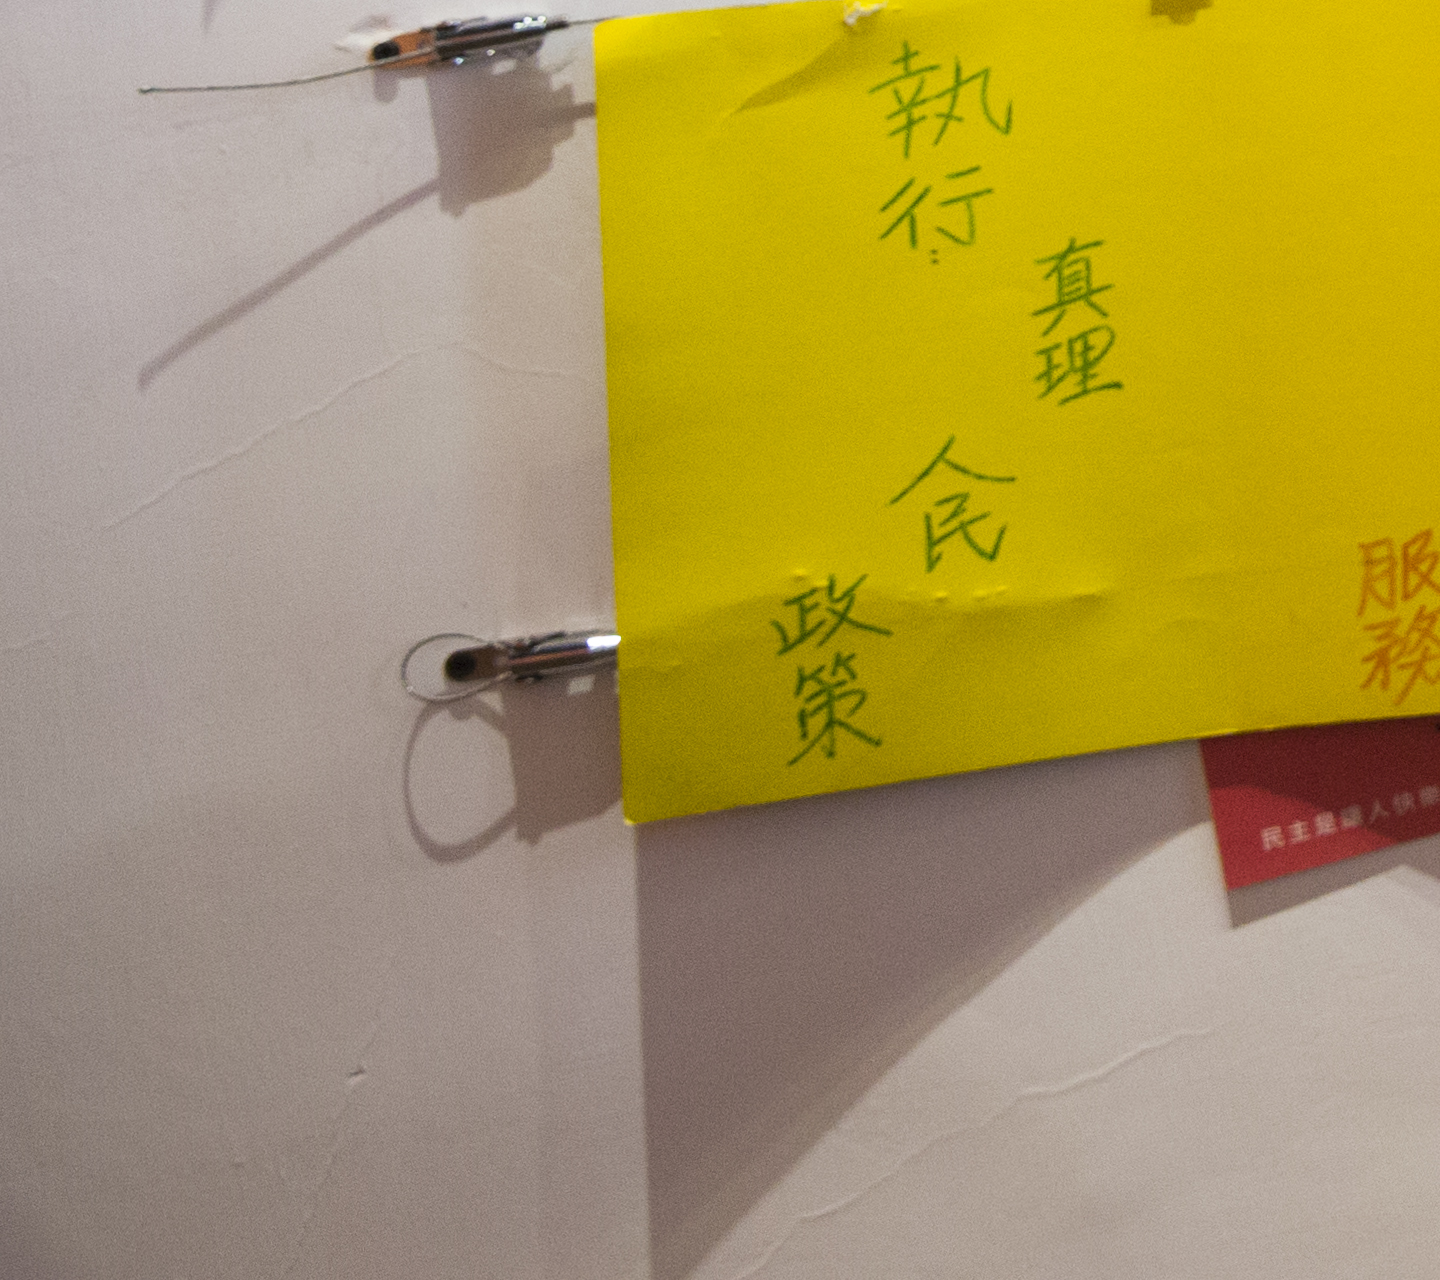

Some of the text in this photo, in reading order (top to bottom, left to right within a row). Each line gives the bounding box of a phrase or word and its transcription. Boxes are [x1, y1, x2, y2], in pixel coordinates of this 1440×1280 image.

[1031, 236, 1124, 406] 真理
[889, 435, 1018, 573] 人民
[768, 572, 894, 768] 政策
